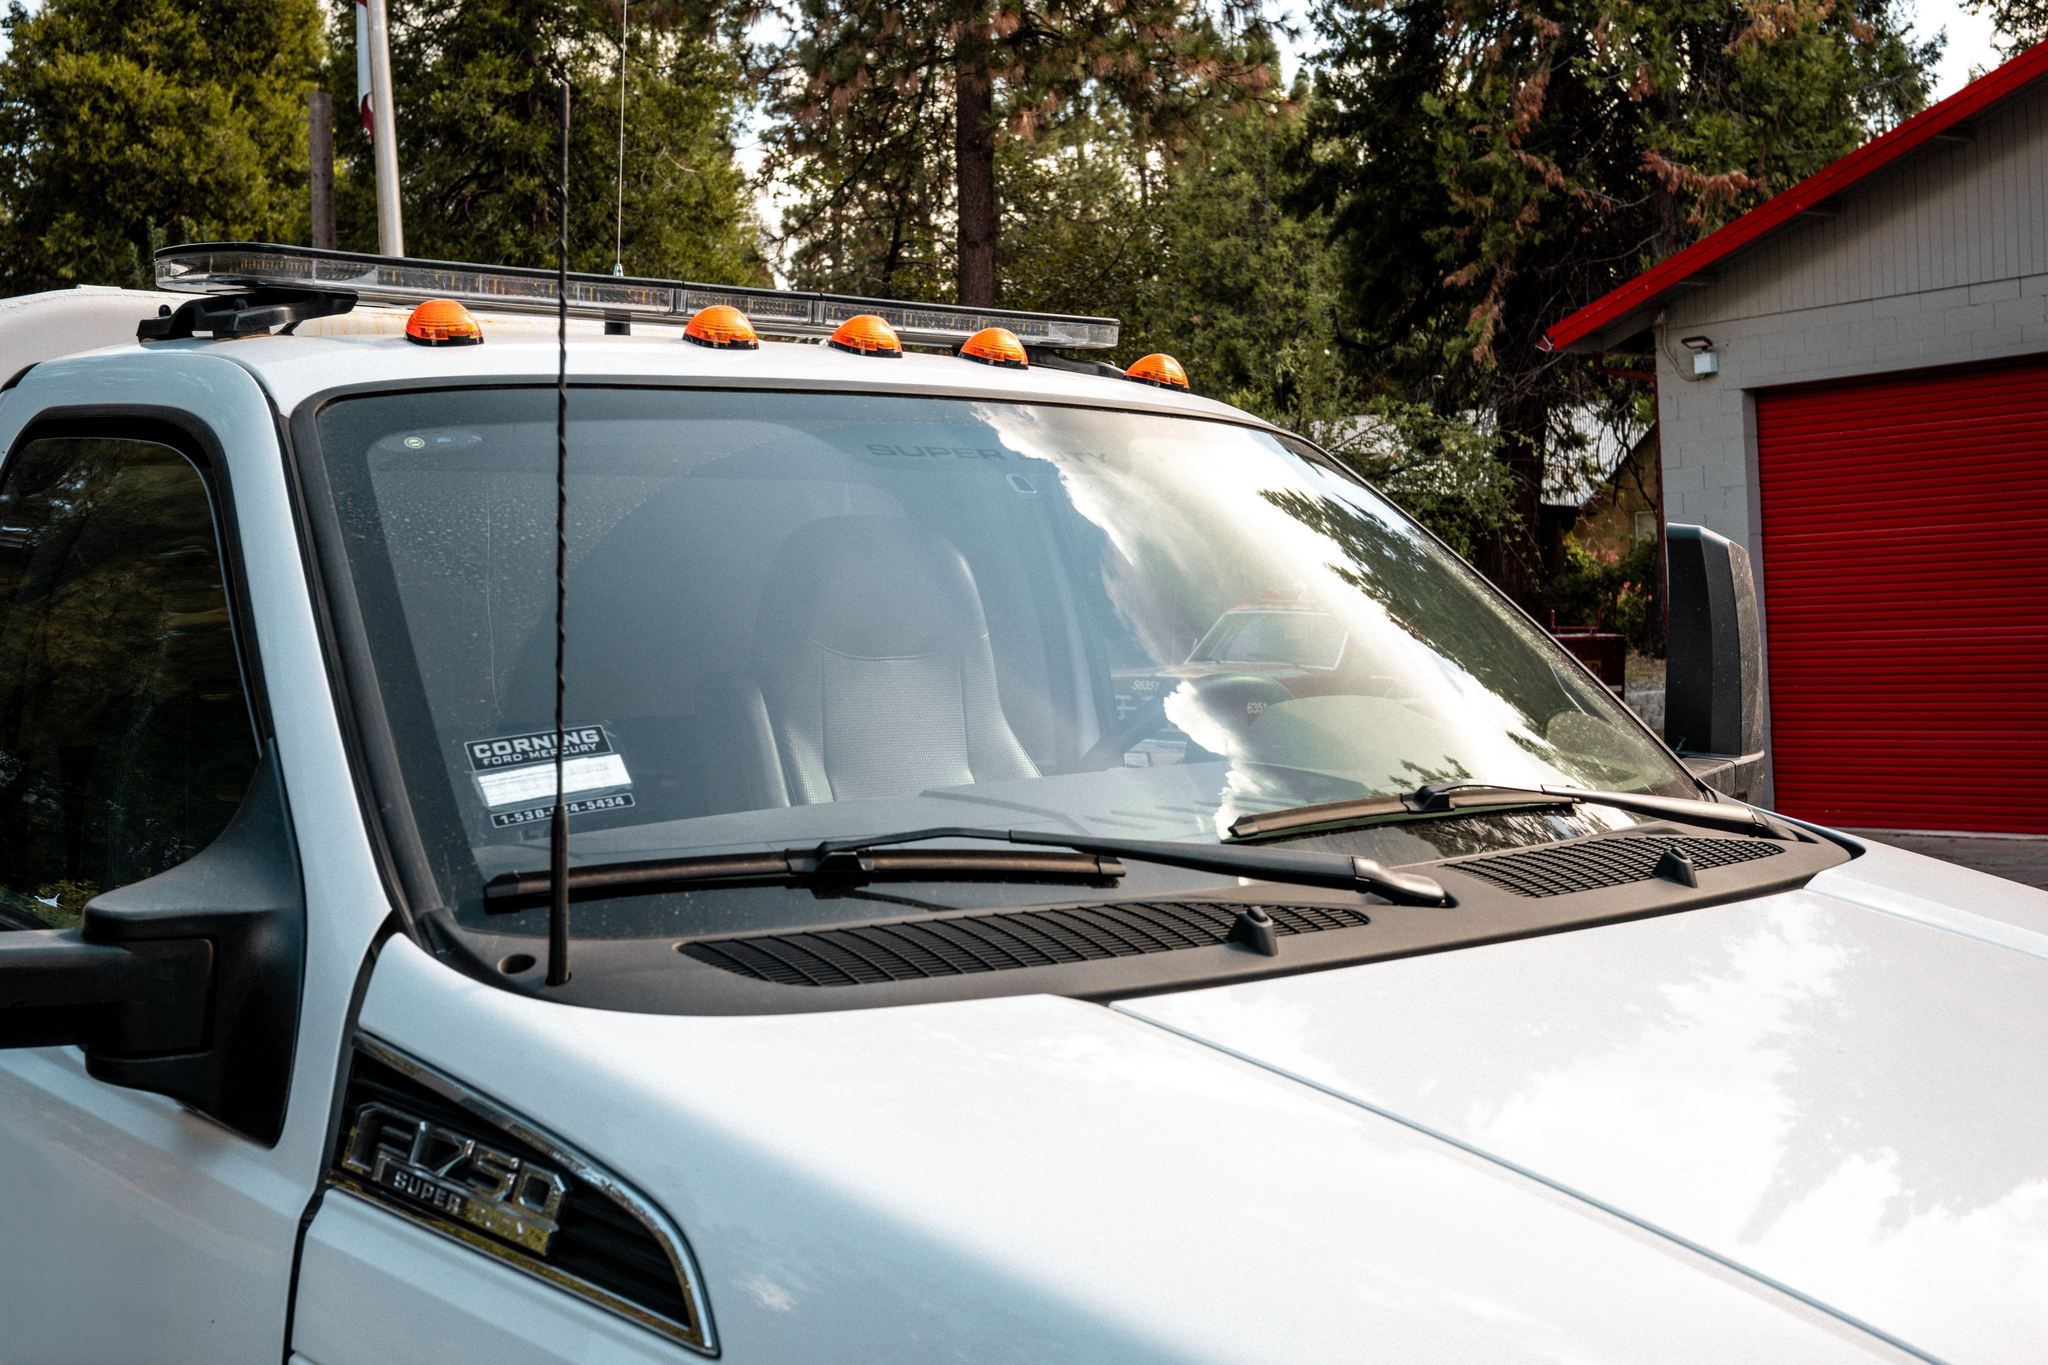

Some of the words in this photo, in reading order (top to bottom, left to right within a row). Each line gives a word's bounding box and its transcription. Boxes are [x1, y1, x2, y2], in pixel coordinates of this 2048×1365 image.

[865, 443, 1005, 460] SUPER
[473, 729, 600, 759] CORNING
[483, 743, 597, 766] FORD-MERCURY
[394, 1171, 461, 1214] SUPER
[471, 1208, 528, 1241] DUTY
